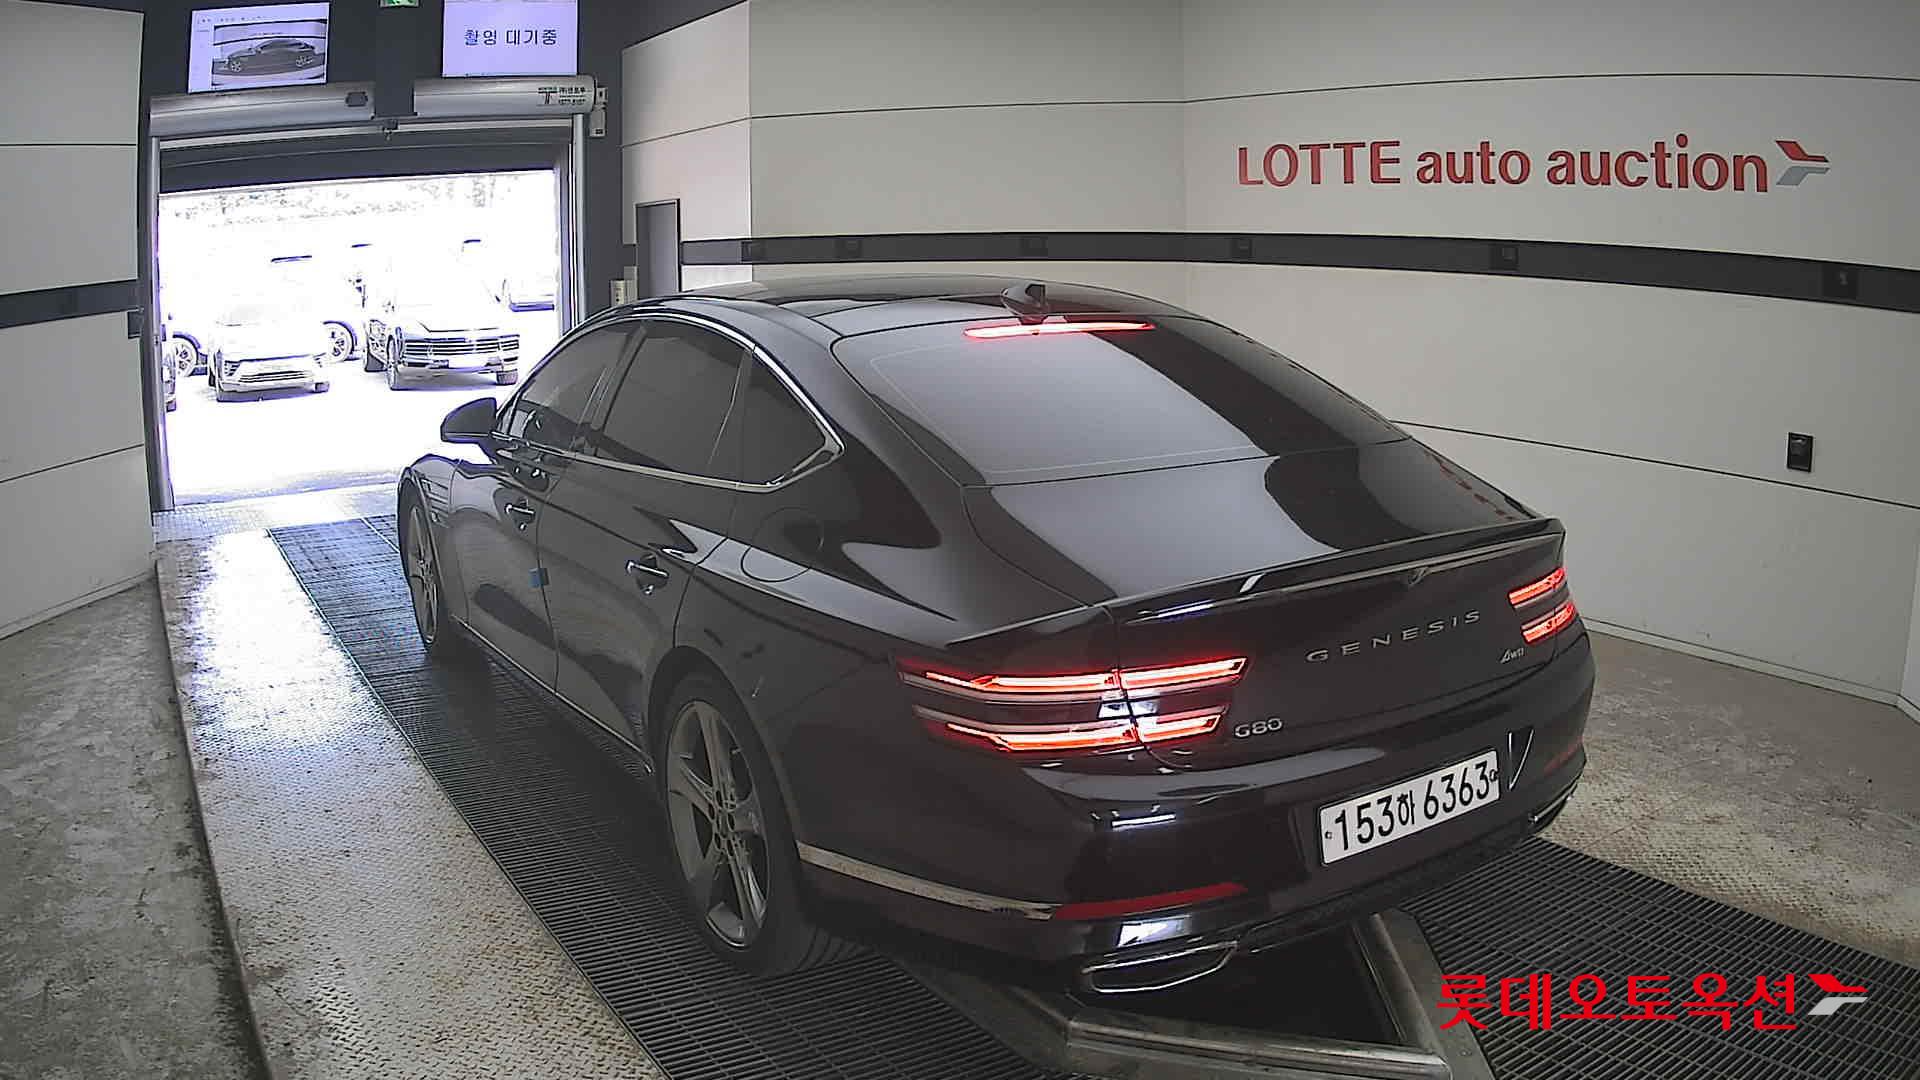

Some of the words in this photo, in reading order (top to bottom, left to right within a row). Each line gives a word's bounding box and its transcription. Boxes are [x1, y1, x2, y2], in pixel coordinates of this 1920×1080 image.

[506, 29, 557, 46] 대기중
[1238, 139, 1400, 187] LOTTE
[1415, 141, 1531, 185] auto
[1546, 133, 1769, 193] auction
[1305, 609, 1481, 663] GENESIS
[1234, 717, 1284, 738] G80
[1423, 761, 1490, 821] 6363
